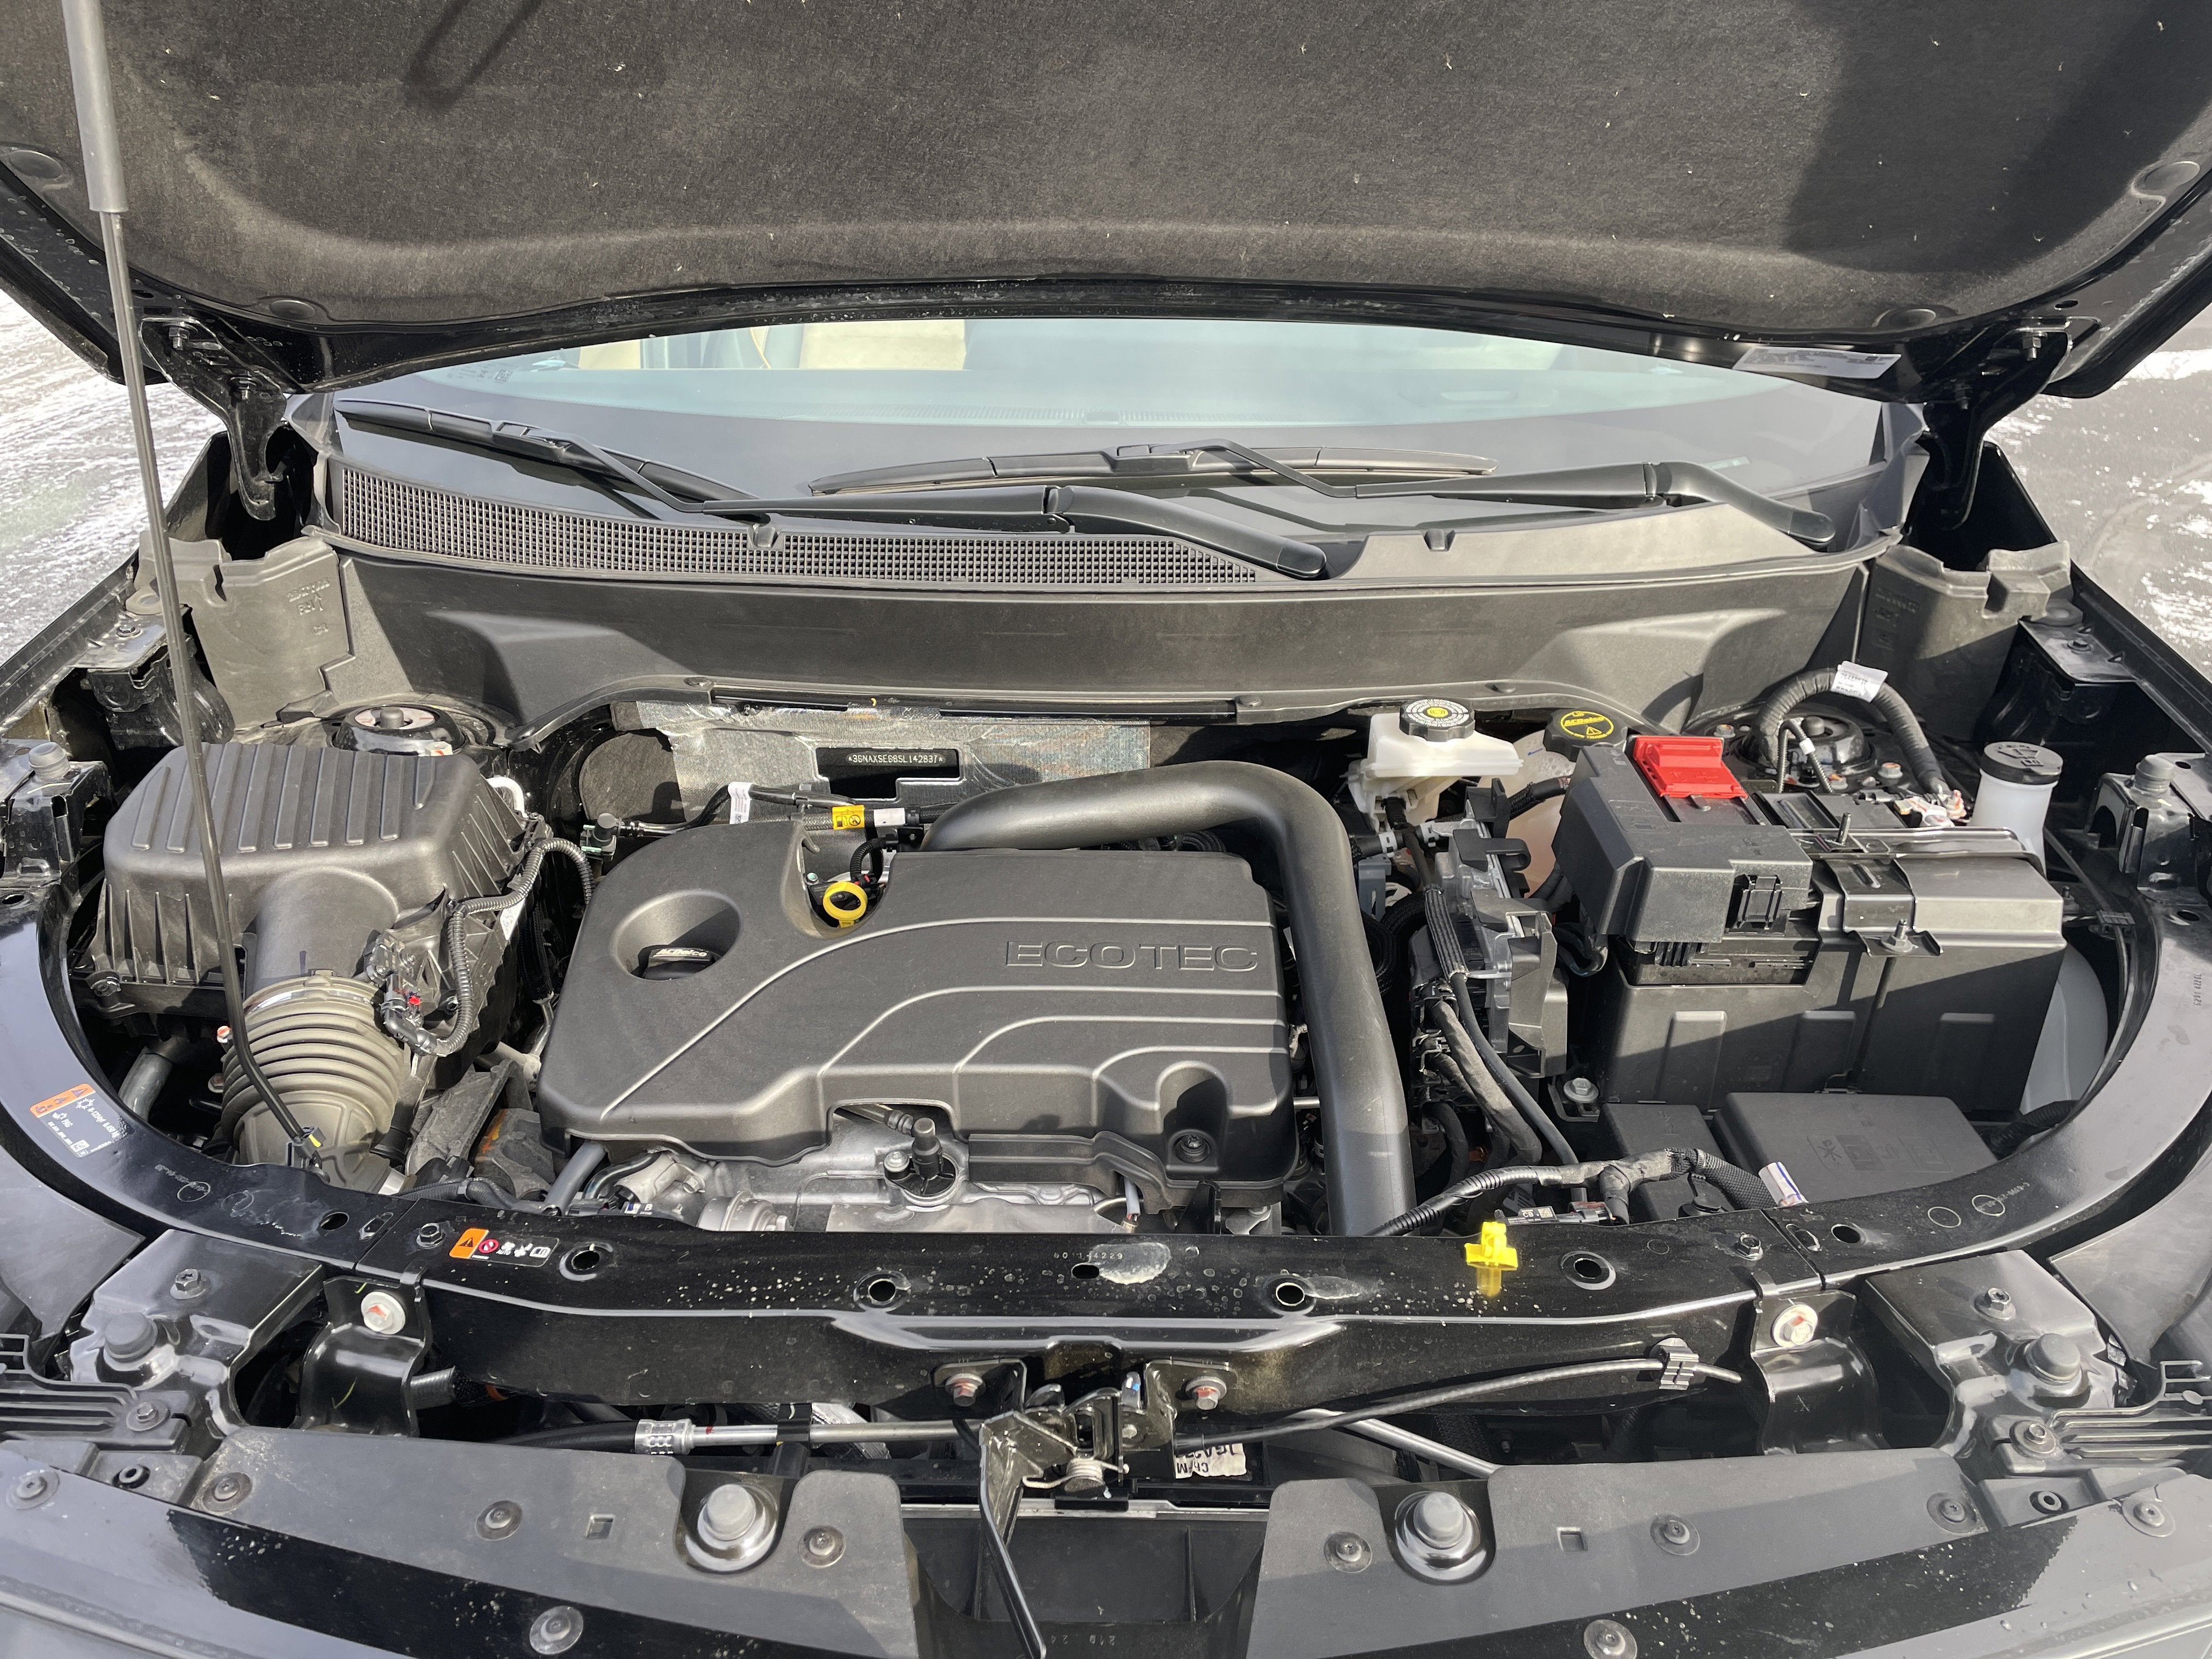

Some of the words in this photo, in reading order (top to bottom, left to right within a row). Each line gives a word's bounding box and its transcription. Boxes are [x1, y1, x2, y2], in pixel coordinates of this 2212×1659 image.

[653, 949, 708, 957] ACDelco
[1006, 941, 1258, 972] ECOTEC
[61, 1119, 74, 1128] PAG
